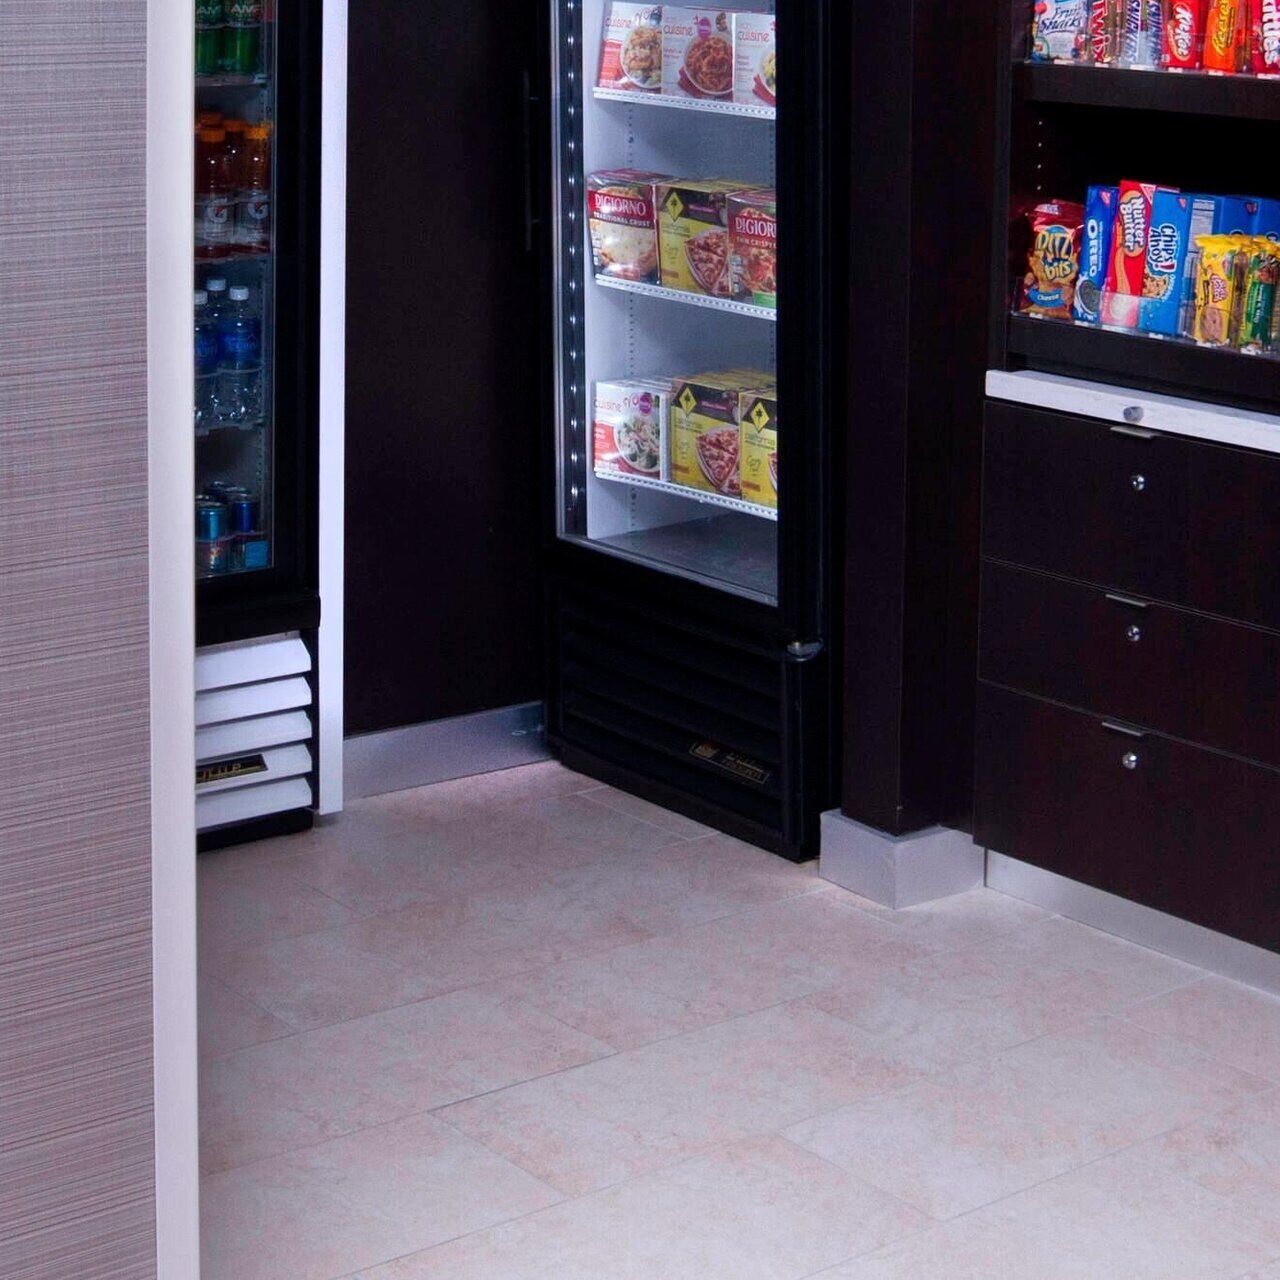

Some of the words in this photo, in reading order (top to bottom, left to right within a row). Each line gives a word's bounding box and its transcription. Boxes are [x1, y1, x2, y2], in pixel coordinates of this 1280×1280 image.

[594, 193, 648, 217] DIGIORNO
[1120, 202, 1136, 253] Butter
[1130, 195, 1147, 251] Nutter
[1087, 219, 1099, 278] OREO
[1160, 222, 1177, 265] Chips
[1041, 259, 1071, 281] bits
